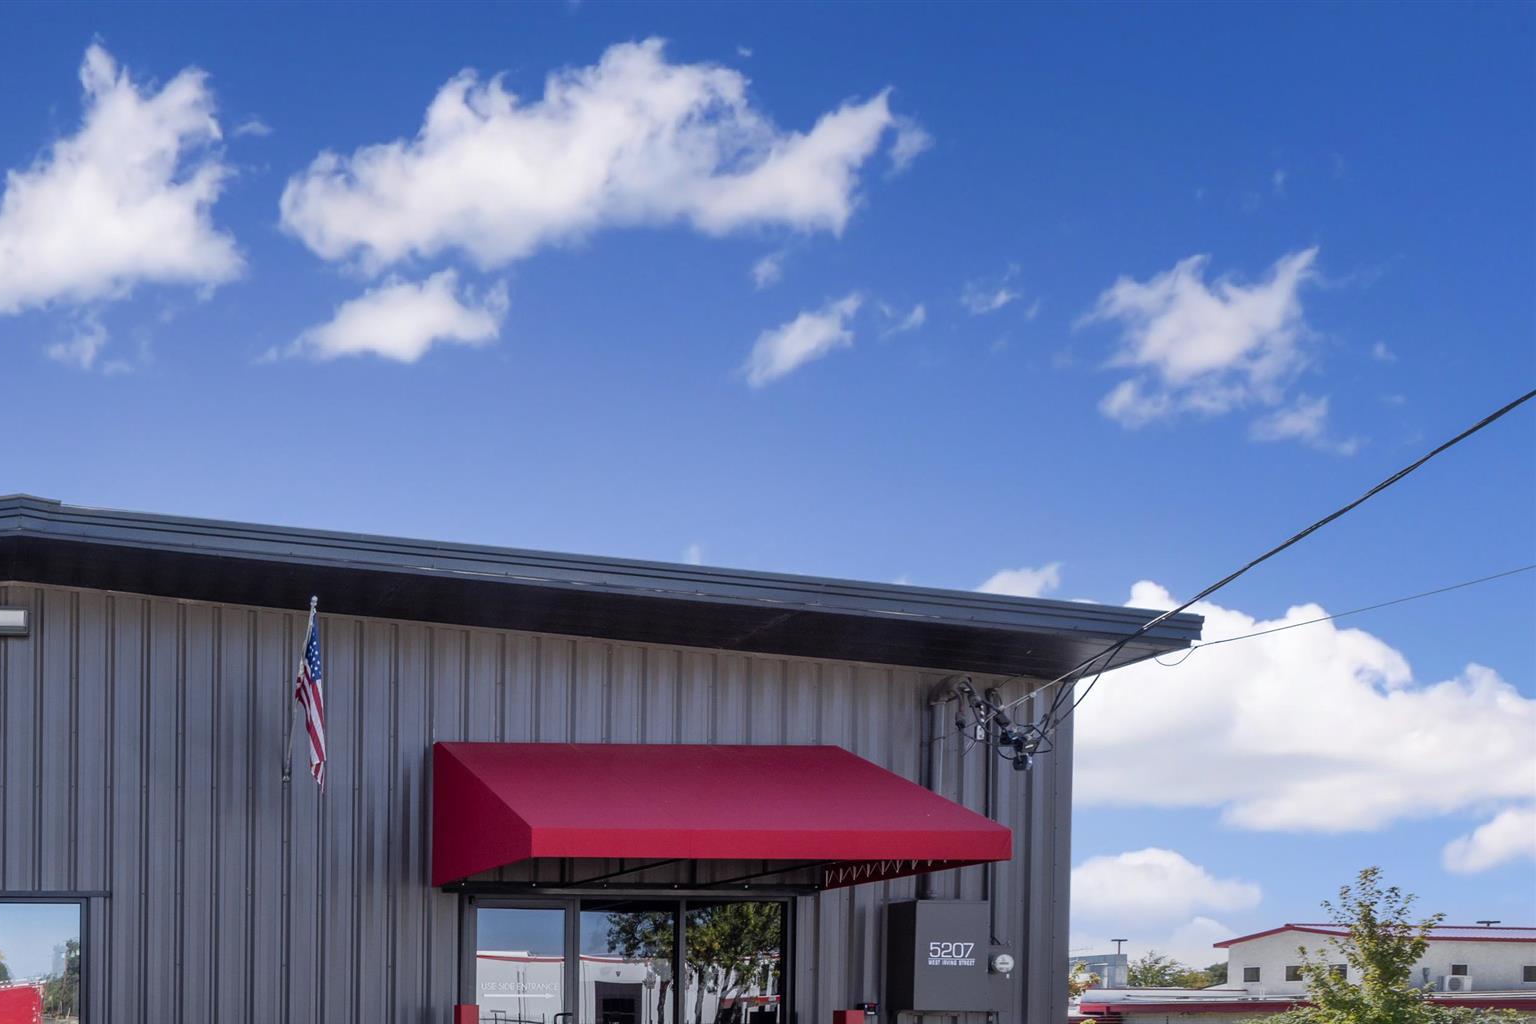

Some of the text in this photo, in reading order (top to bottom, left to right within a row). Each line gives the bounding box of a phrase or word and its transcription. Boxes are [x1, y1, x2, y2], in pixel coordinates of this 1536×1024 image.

[929, 942, 975, 958] 5207
[481, 982, 498, 992] USE
[516, 982, 560, 991] ENTRANCE
